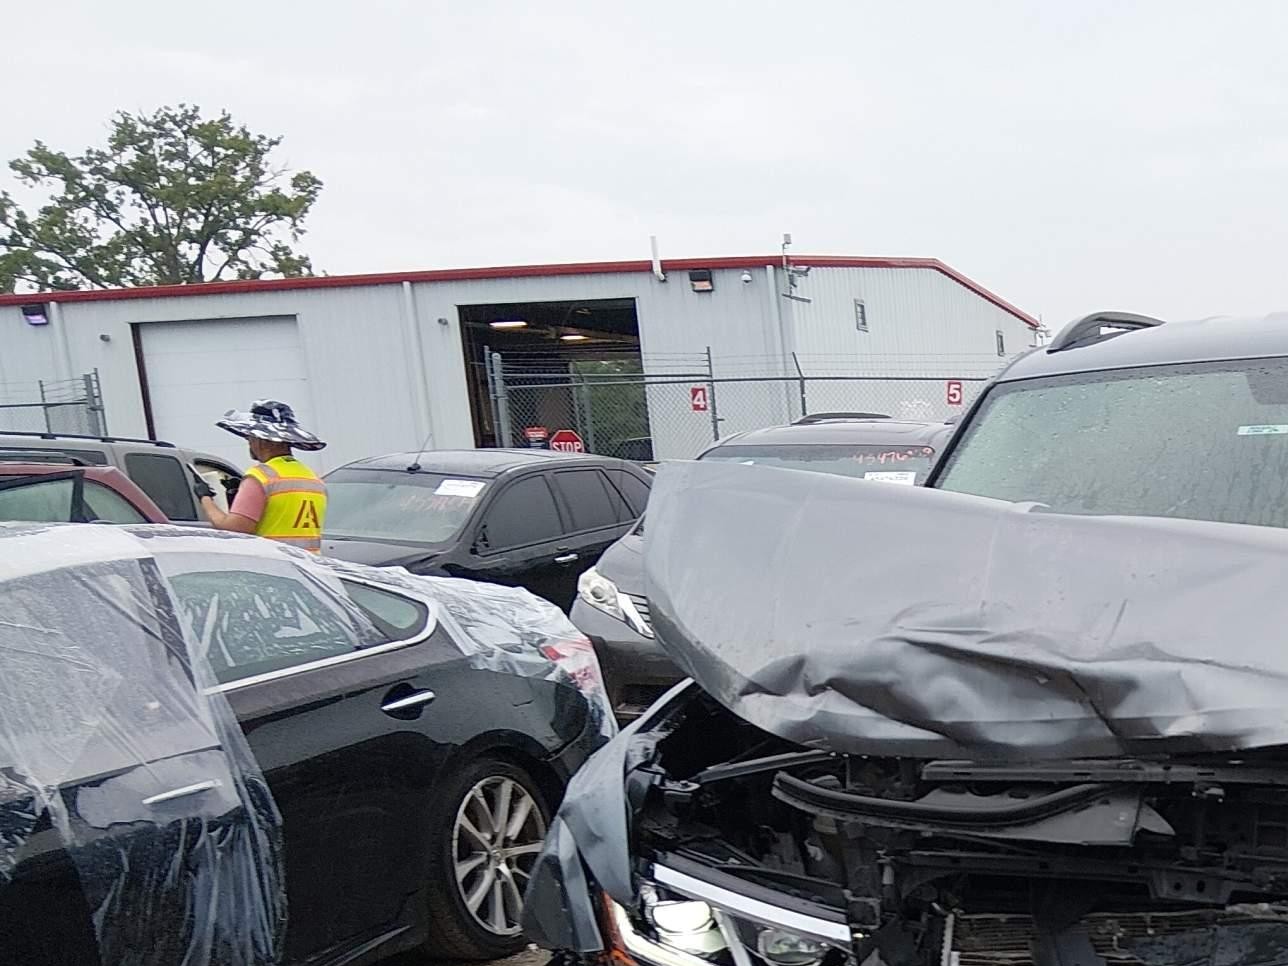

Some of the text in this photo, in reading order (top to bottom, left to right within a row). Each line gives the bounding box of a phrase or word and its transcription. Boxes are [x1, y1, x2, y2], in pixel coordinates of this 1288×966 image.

[693, 390, 706, 408] 4
[948, 383, 961, 402] 5
[552, 441, 582, 453] STOP
